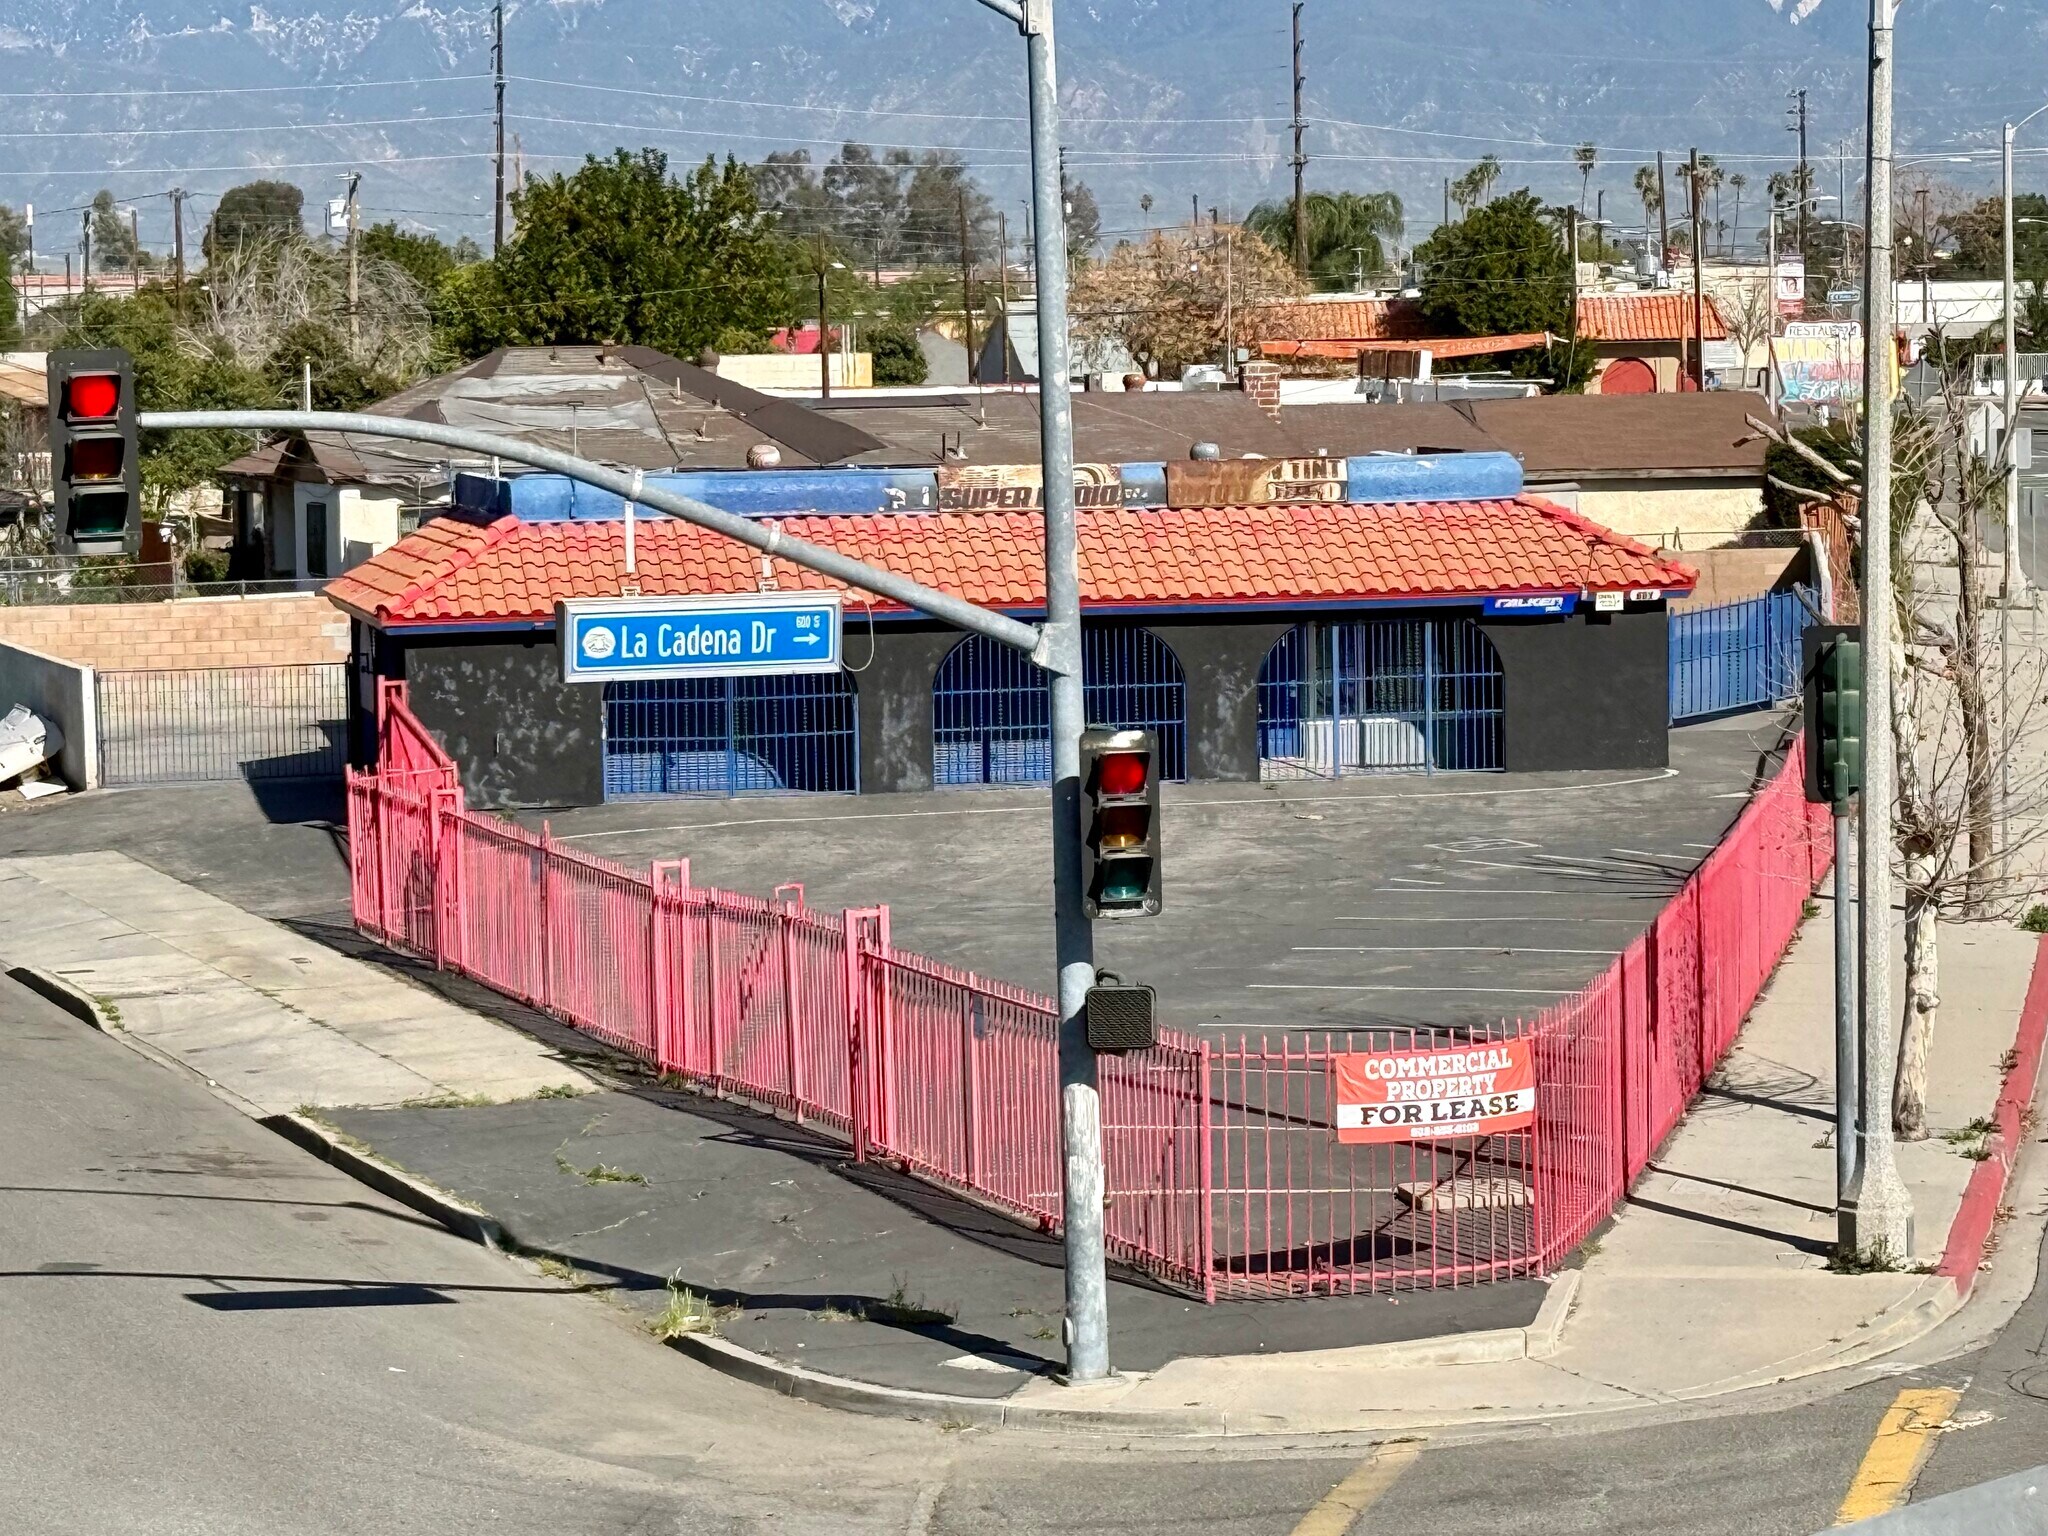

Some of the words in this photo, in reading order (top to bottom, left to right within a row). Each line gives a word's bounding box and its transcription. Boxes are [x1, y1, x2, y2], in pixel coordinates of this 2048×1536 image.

[1288, 459, 1342, 480] TINT
[939, 486, 1033, 508] SUPER
[1494, 597, 1563, 609] FALKEN
[621, 625, 647, 658] La
[657, 624, 741, 657] Cadena
[752, 621, 777, 653] Dr
[1365, 1048, 1513, 1080] COMMERCIAL
[1386, 1072, 1497, 1102] PROPERTY
[1361, 1104, 1423, 1125] FOR
[1430, 1093, 1519, 1121] LEASE
